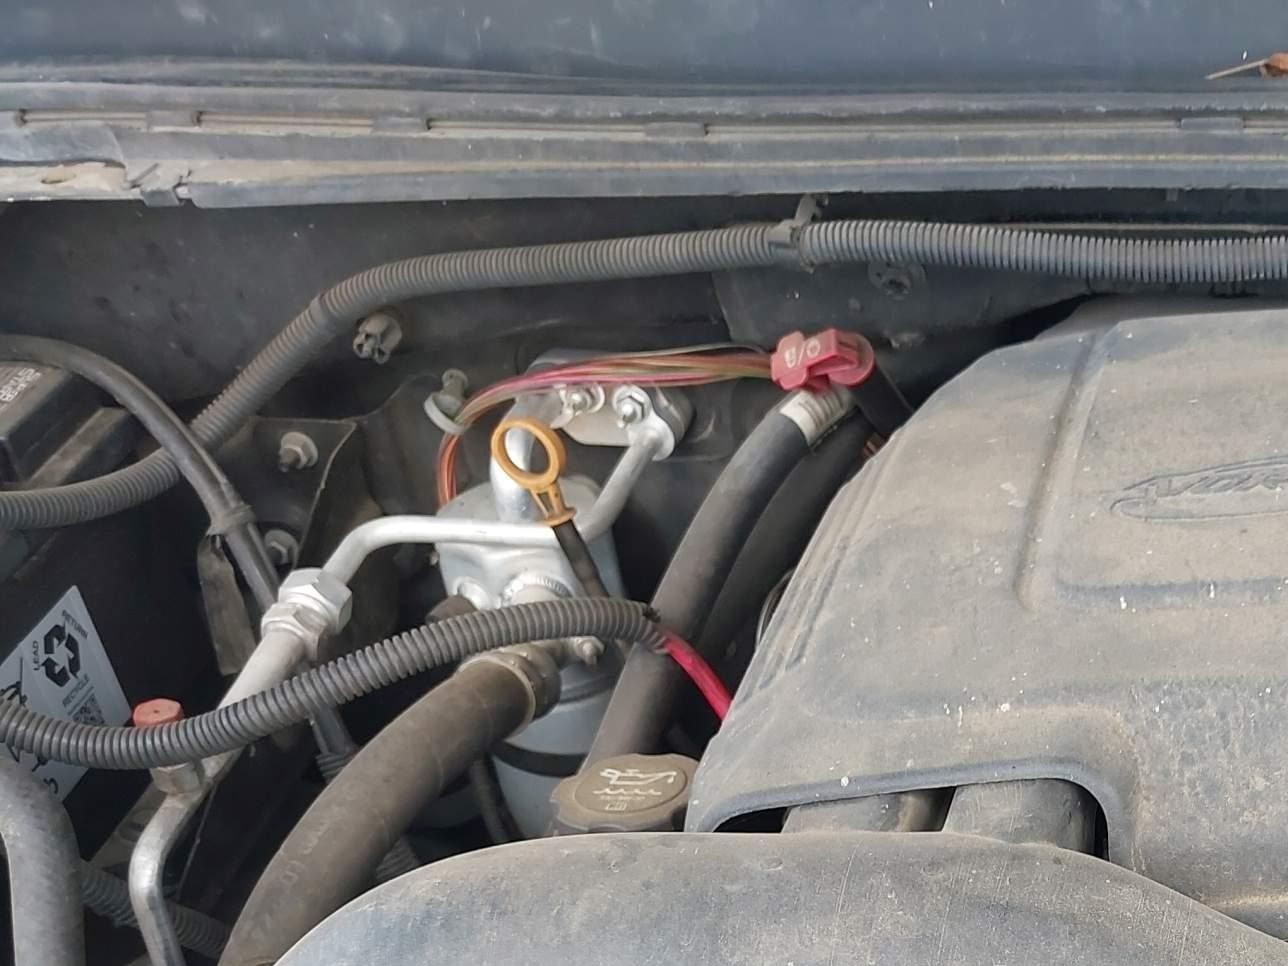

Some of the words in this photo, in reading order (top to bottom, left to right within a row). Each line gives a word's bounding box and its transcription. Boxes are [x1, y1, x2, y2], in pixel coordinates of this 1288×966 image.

[61, 609, 88, 640] RETURN
[32, 640, 40, 671] LEAD
[62, 673, 90, 708] RECYCLE
